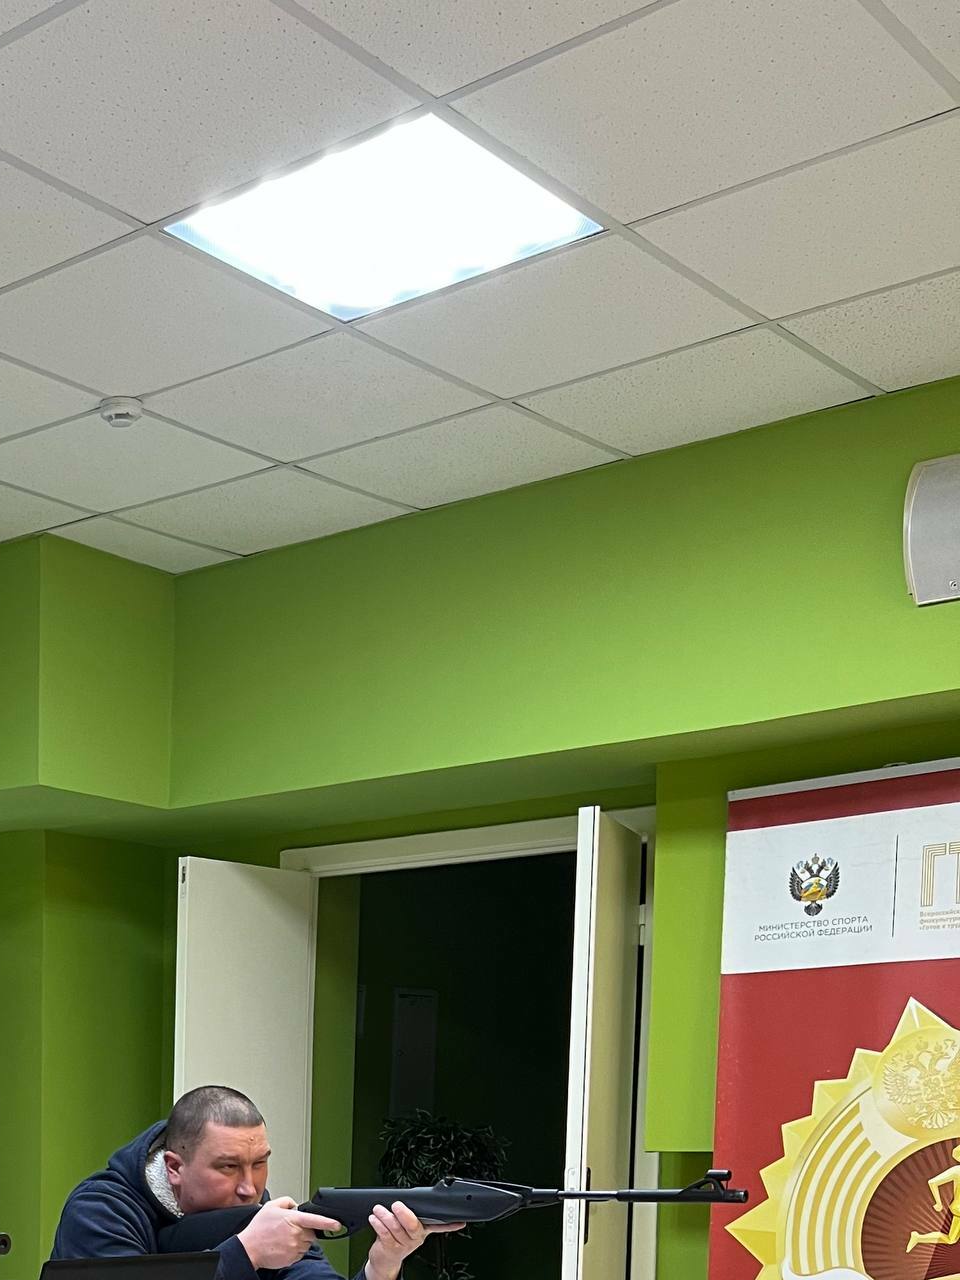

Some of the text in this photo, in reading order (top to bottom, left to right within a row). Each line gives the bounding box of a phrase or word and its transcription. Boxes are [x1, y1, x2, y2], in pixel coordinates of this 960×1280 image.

[758, 915, 869, 931] МИНИСТЕРСТВО СПОРТА
[754, 925, 873, 942] РОССИЙСКОЙ ФЕДЕРАЦИИ
